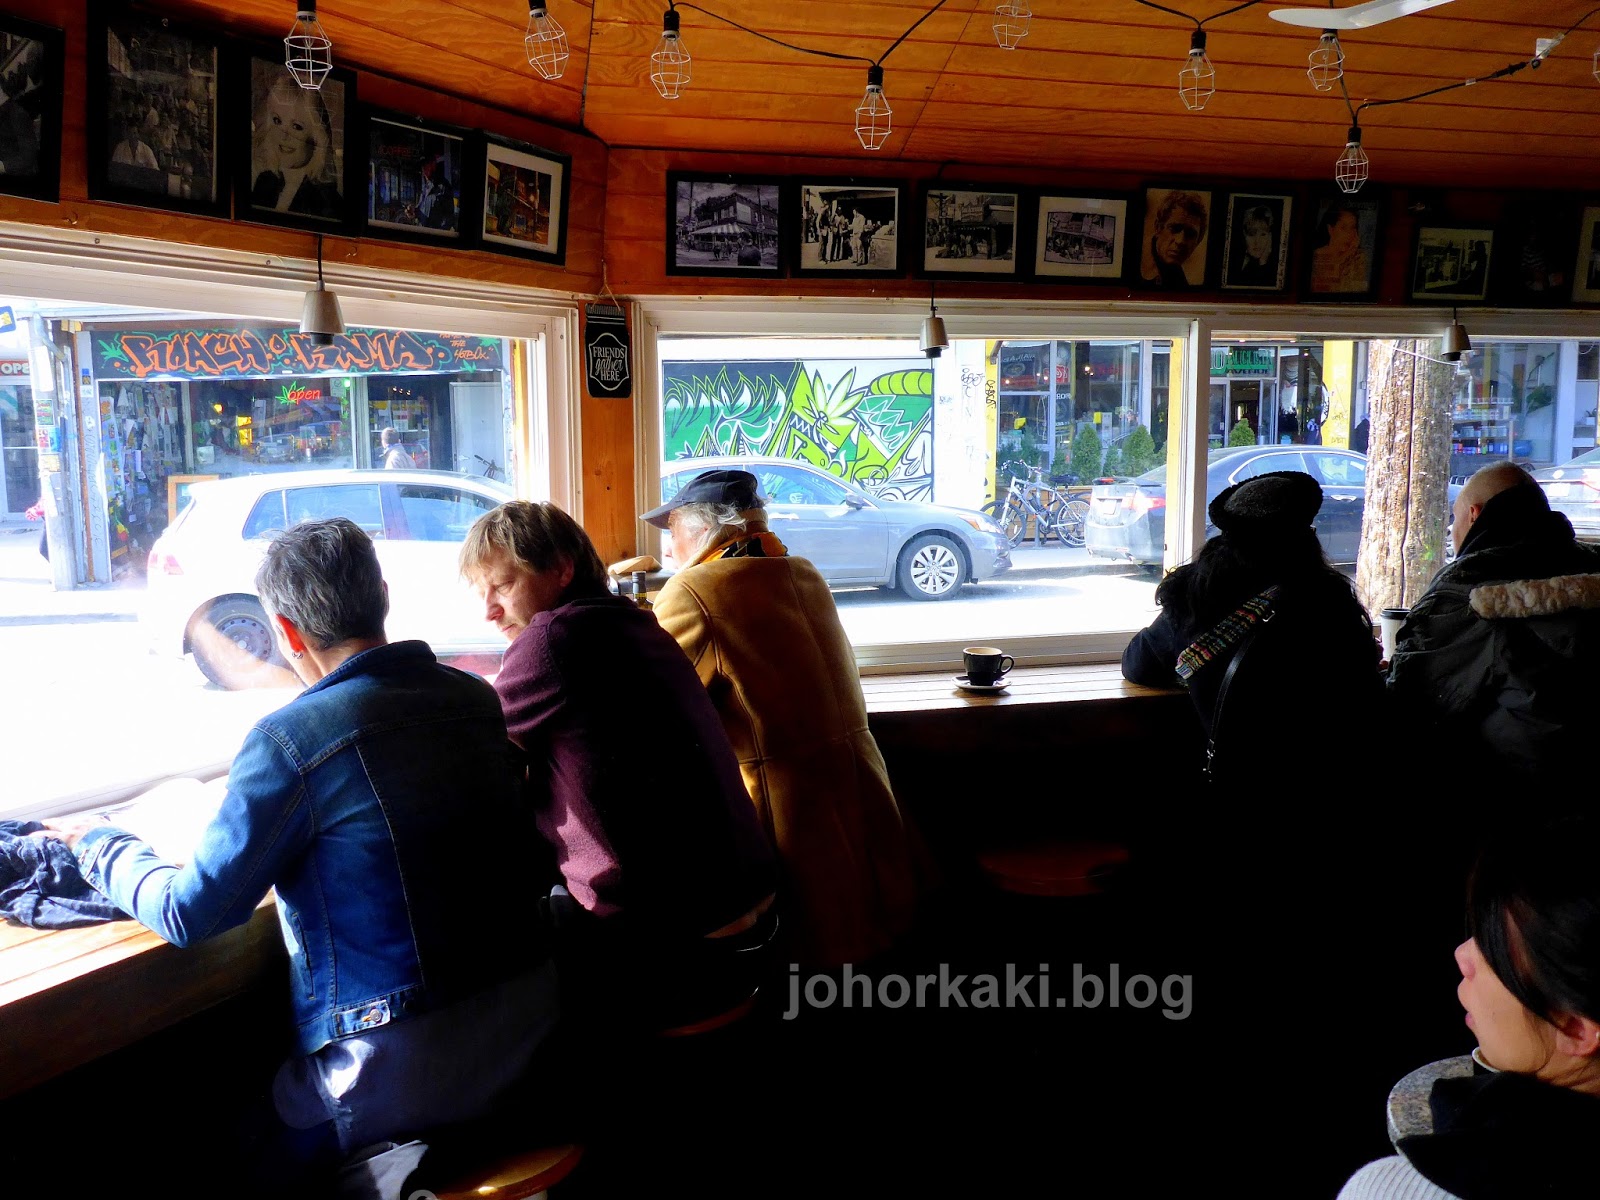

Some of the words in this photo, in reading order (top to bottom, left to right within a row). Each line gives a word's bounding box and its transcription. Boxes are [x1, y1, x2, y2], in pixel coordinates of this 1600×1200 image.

[593, 346, 625, 359] FRIENDS
[1, 362, 30, 375] OPE
[600, 369, 621, 381] HERE
